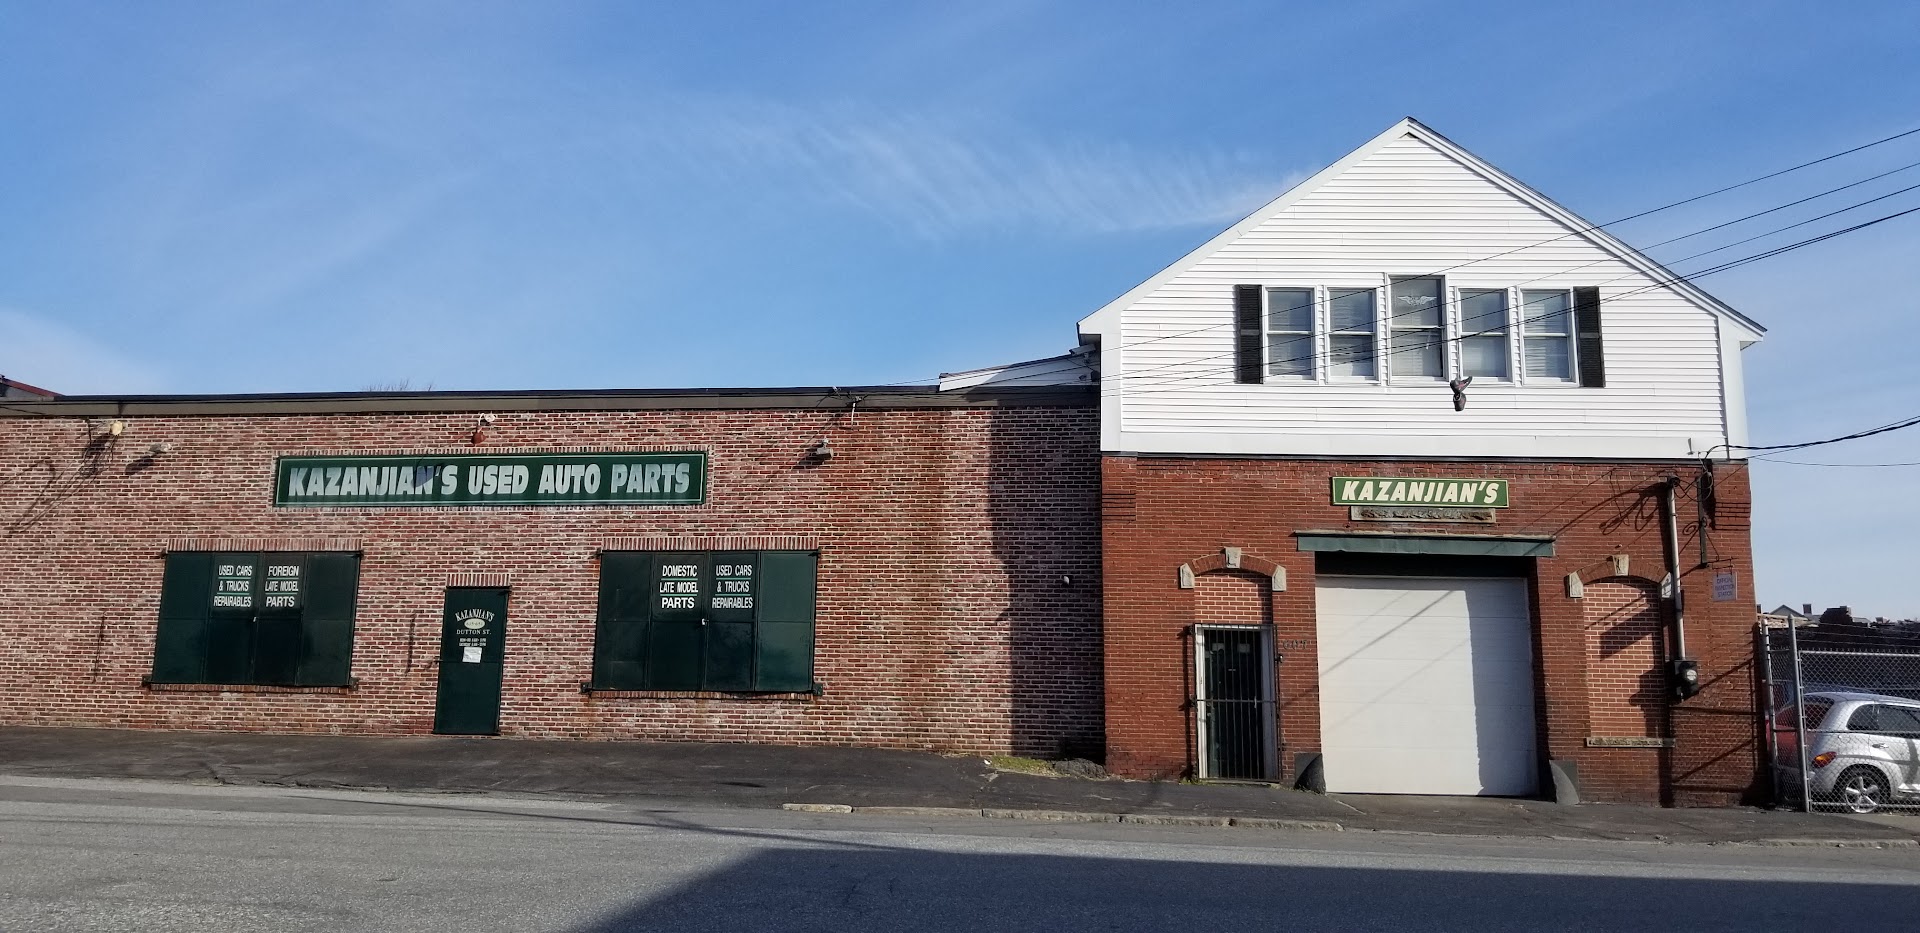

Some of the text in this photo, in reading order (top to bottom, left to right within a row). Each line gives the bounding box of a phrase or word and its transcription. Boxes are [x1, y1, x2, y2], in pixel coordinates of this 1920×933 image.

[288, 463, 691, 497] KAZANJIAN'S USED AUTO PARTS
[1341, 480, 1499, 504] KAZANJIAN'S
[218, 565, 253, 577] USED CARS
[268, 565, 300, 577] FOREIGN
[662, 564, 698, 577] DOMESTIC
[715, 564, 753, 577] USED CARS
[219, 580, 250, 592] & TRUCKS
[265, 581, 299, 592] LATE MODEL
[659, 581, 699, 593] LATE MODEL
[716, 581, 750, 593] & TRUCKS
[213, 595, 252, 607] REPAIRABLES
[265, 595, 295, 608] PARTS
[661, 597, 695, 609] PARTS
[711, 597, 753, 609] REPAIRABLES
